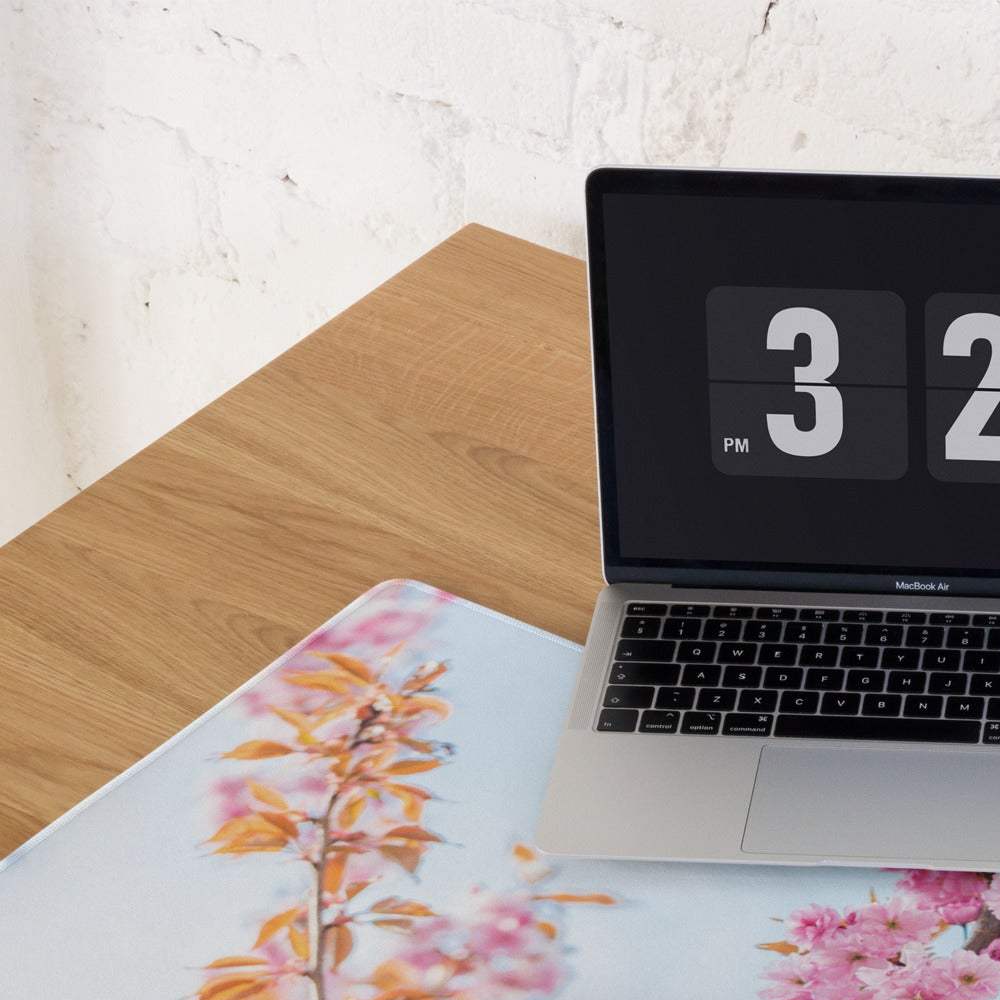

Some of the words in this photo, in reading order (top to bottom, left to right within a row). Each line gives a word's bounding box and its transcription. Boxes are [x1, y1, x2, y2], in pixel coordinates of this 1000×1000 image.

[766, 306, 843, 457] 3
[723, 437, 749, 453] PM
[895, 581, 936, 591] MacBook
[937, 582, 950, 591] Air
[692, 648, 701, 656] Q
